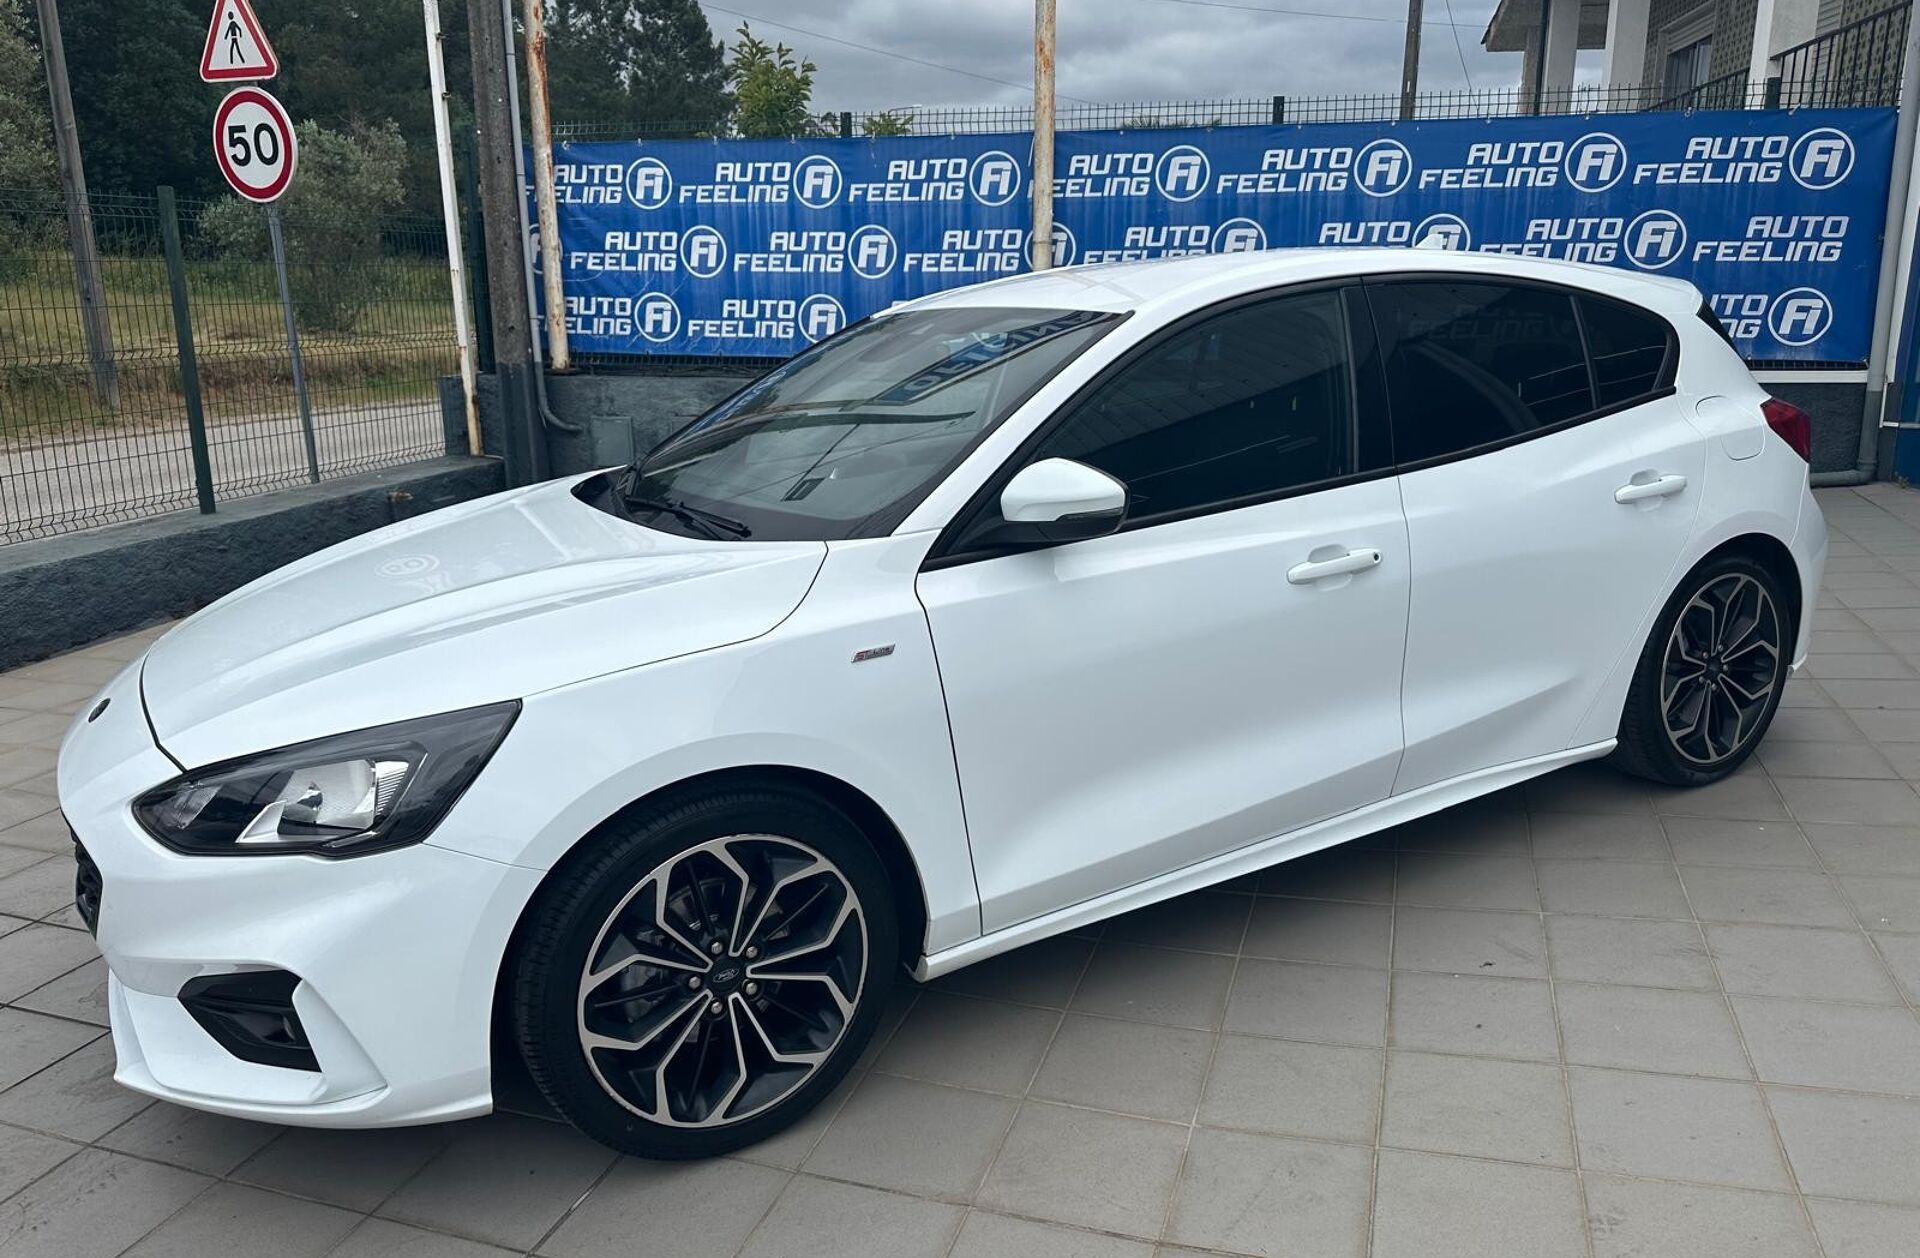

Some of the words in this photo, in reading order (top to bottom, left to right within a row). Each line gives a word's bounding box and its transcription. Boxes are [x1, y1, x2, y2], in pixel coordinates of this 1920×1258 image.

[228, 123, 279, 167] 50
[1466, 141, 1564, 166] AUTO
[1685, 136, 1788, 159] AUTO
[888, 158, 967, 180] AUTO
[1068, 153, 1153, 176] AUTO
[1261, 147, 1352, 171] AUTO
[554, 165, 623, 184] AUTO
[716, 162, 791, 182] AUTO
[1216, 171, 1348, 194] FEELING
[1418, 166, 1558, 189] FEELING
[1632, 161, 1782, 185] FEELING
[679, 184, 789, 203] FEELING
[849, 181, 964, 202] FEELING
[1124, 225, 1210, 247] AUTO
[1318, 221, 1411, 243] AUTO
[1525, 218, 1624, 241] AUTO
[1745, 215, 1849, 239] AUTO
[604, 231, 678, 251] AUTO
[770, 231, 846, 251] AUTO
[942, 229, 1023, 250] AUTO
[570, 251, 677, 271] FEELING
[1692, 241, 1843, 262] FEELING
[733, 253, 844, 273] FEELING
[903, 252, 1020, 273] FEELING
[565, 296, 632, 316] AUTO
[722, 299, 796, 319] AUTO
[688, 319, 795, 339] FEELING
